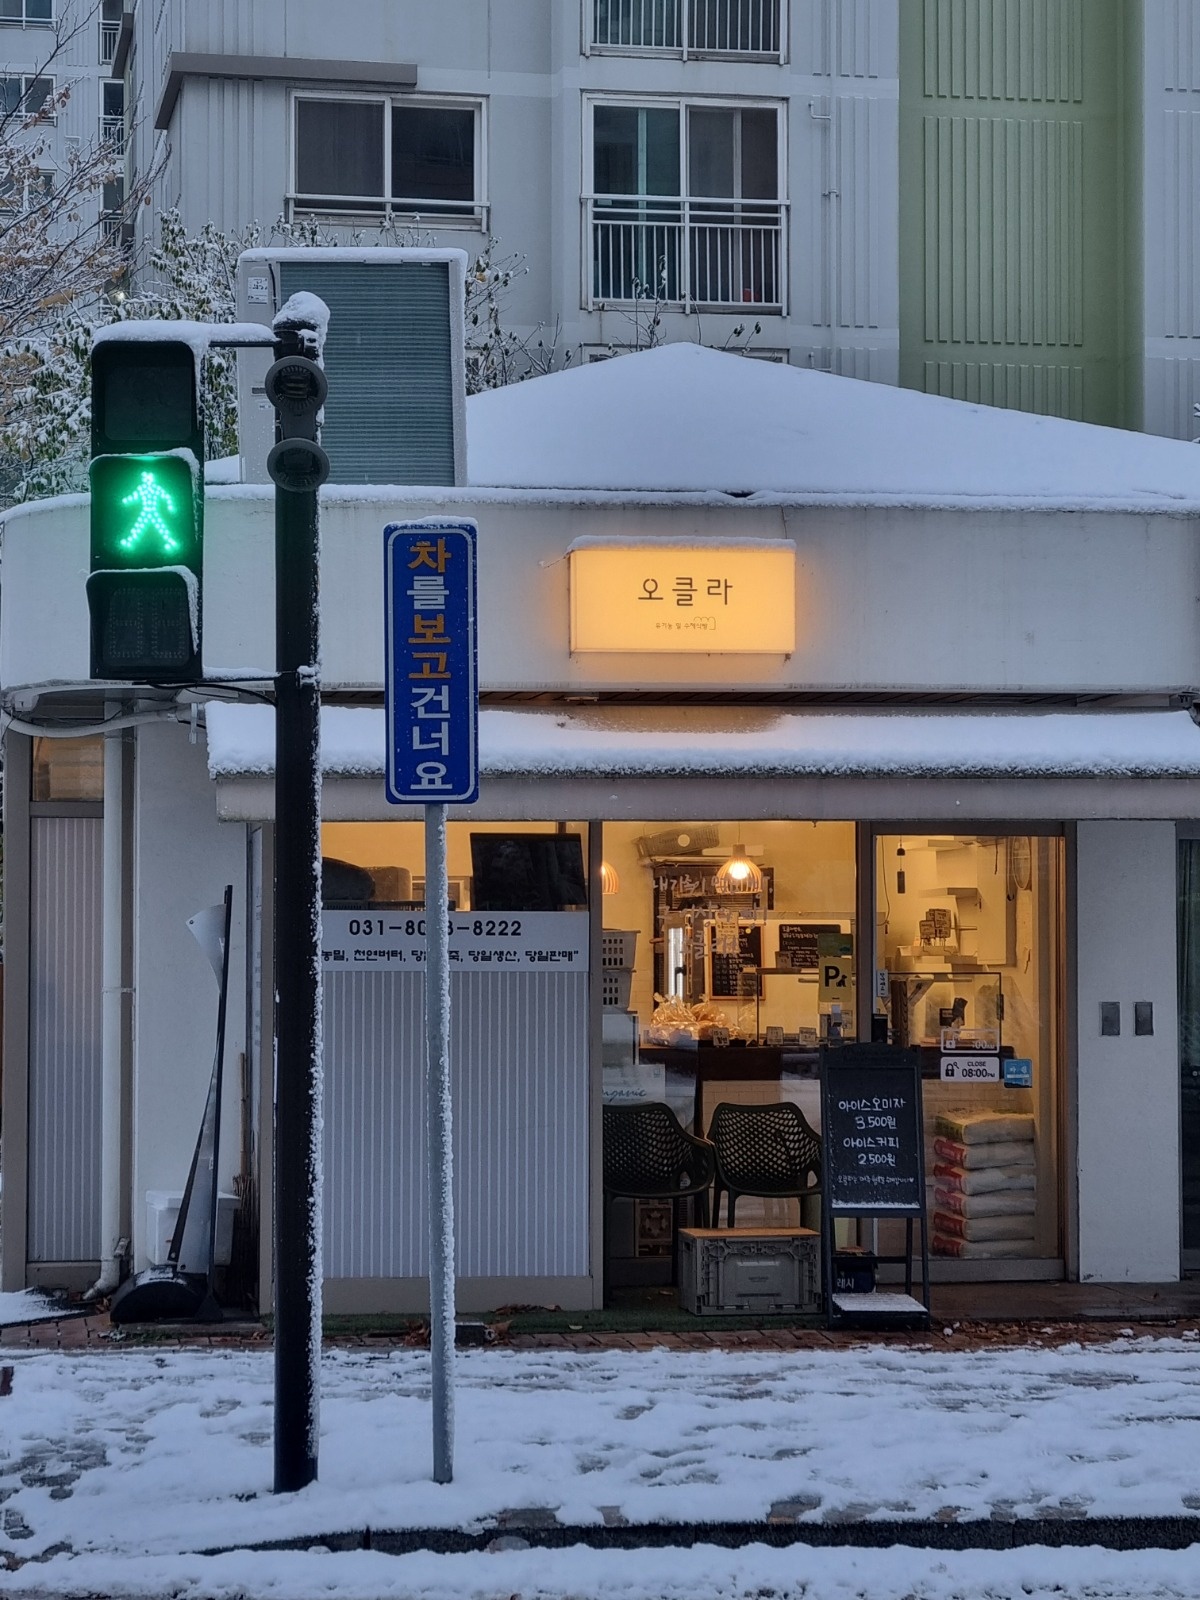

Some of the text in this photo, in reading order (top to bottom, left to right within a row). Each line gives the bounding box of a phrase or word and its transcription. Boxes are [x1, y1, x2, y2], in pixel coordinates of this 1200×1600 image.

[637, 577, 733, 607] 오클라
[353, 949, 406, 963] 천연버터,
[411, 949, 463, 963] 당죽,
[468, 949, 520, 963] 당일생산,
[525, 949, 579, 963] 당일판매"
[824, 965, 840, 987] P
[966, 1060, 987, 1068] CLOSE
[843, 1136, 900, 1149] 아이스커피
